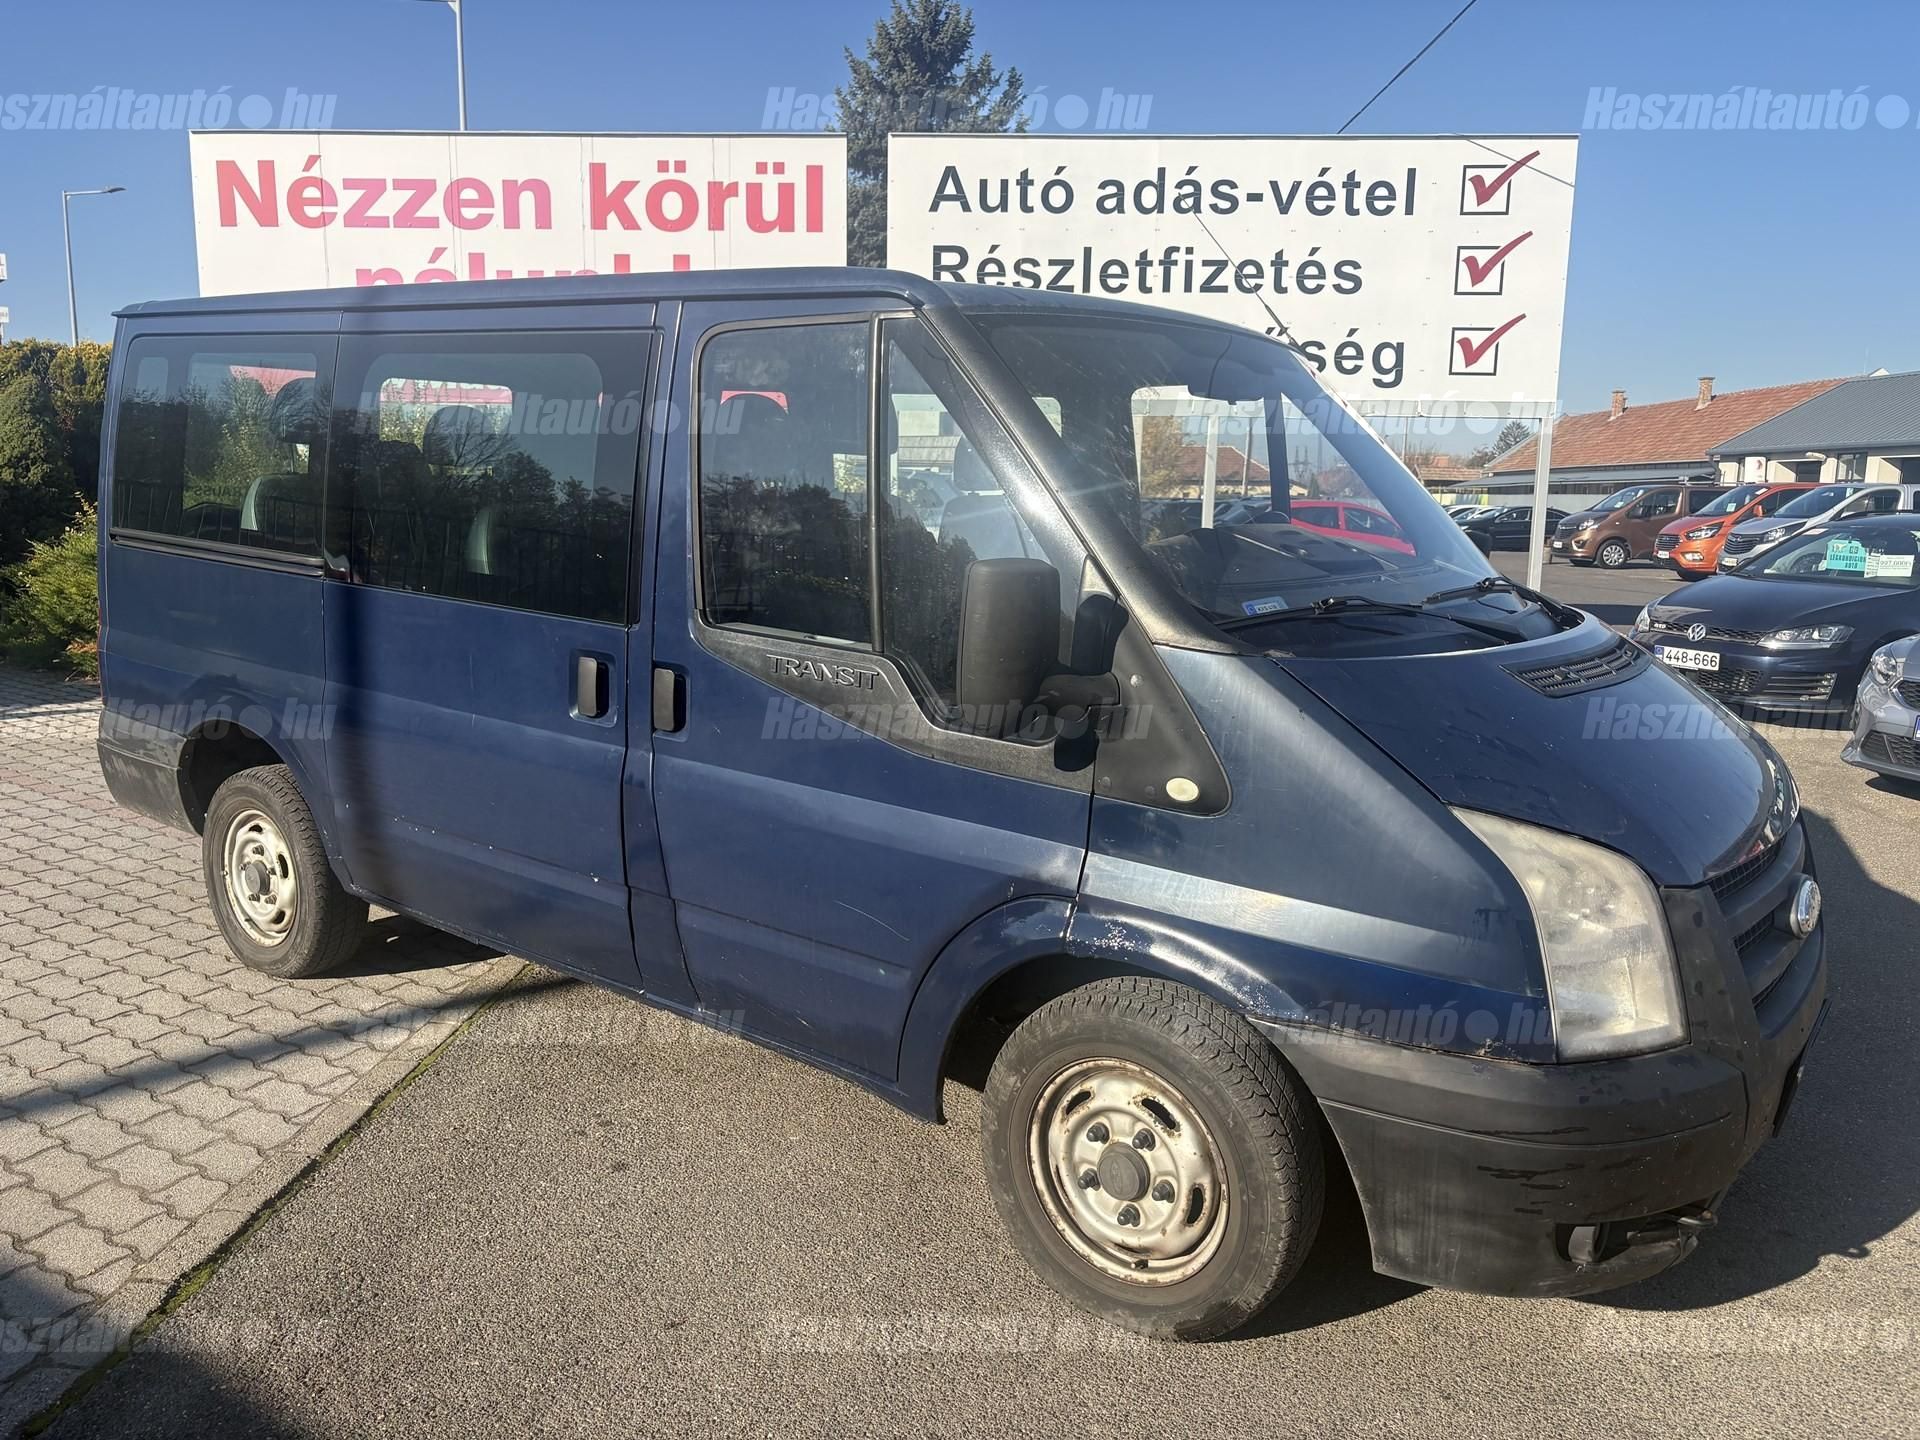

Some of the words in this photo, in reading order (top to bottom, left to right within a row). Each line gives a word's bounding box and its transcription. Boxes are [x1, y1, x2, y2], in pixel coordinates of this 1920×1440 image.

[215, 155, 553, 230] Nézzen
[588, 160, 824, 233] körül
[928, 165, 1074, 215] Autó
[1096, 165, 1417, 216] adás-vétel
[933, 244, 1363, 295] Részletfizetés
[1266, 327, 1405, 389] ség
[765, 653, 880, 690] TRANSIT
[1665, 649, 1718, 668] 448-666
